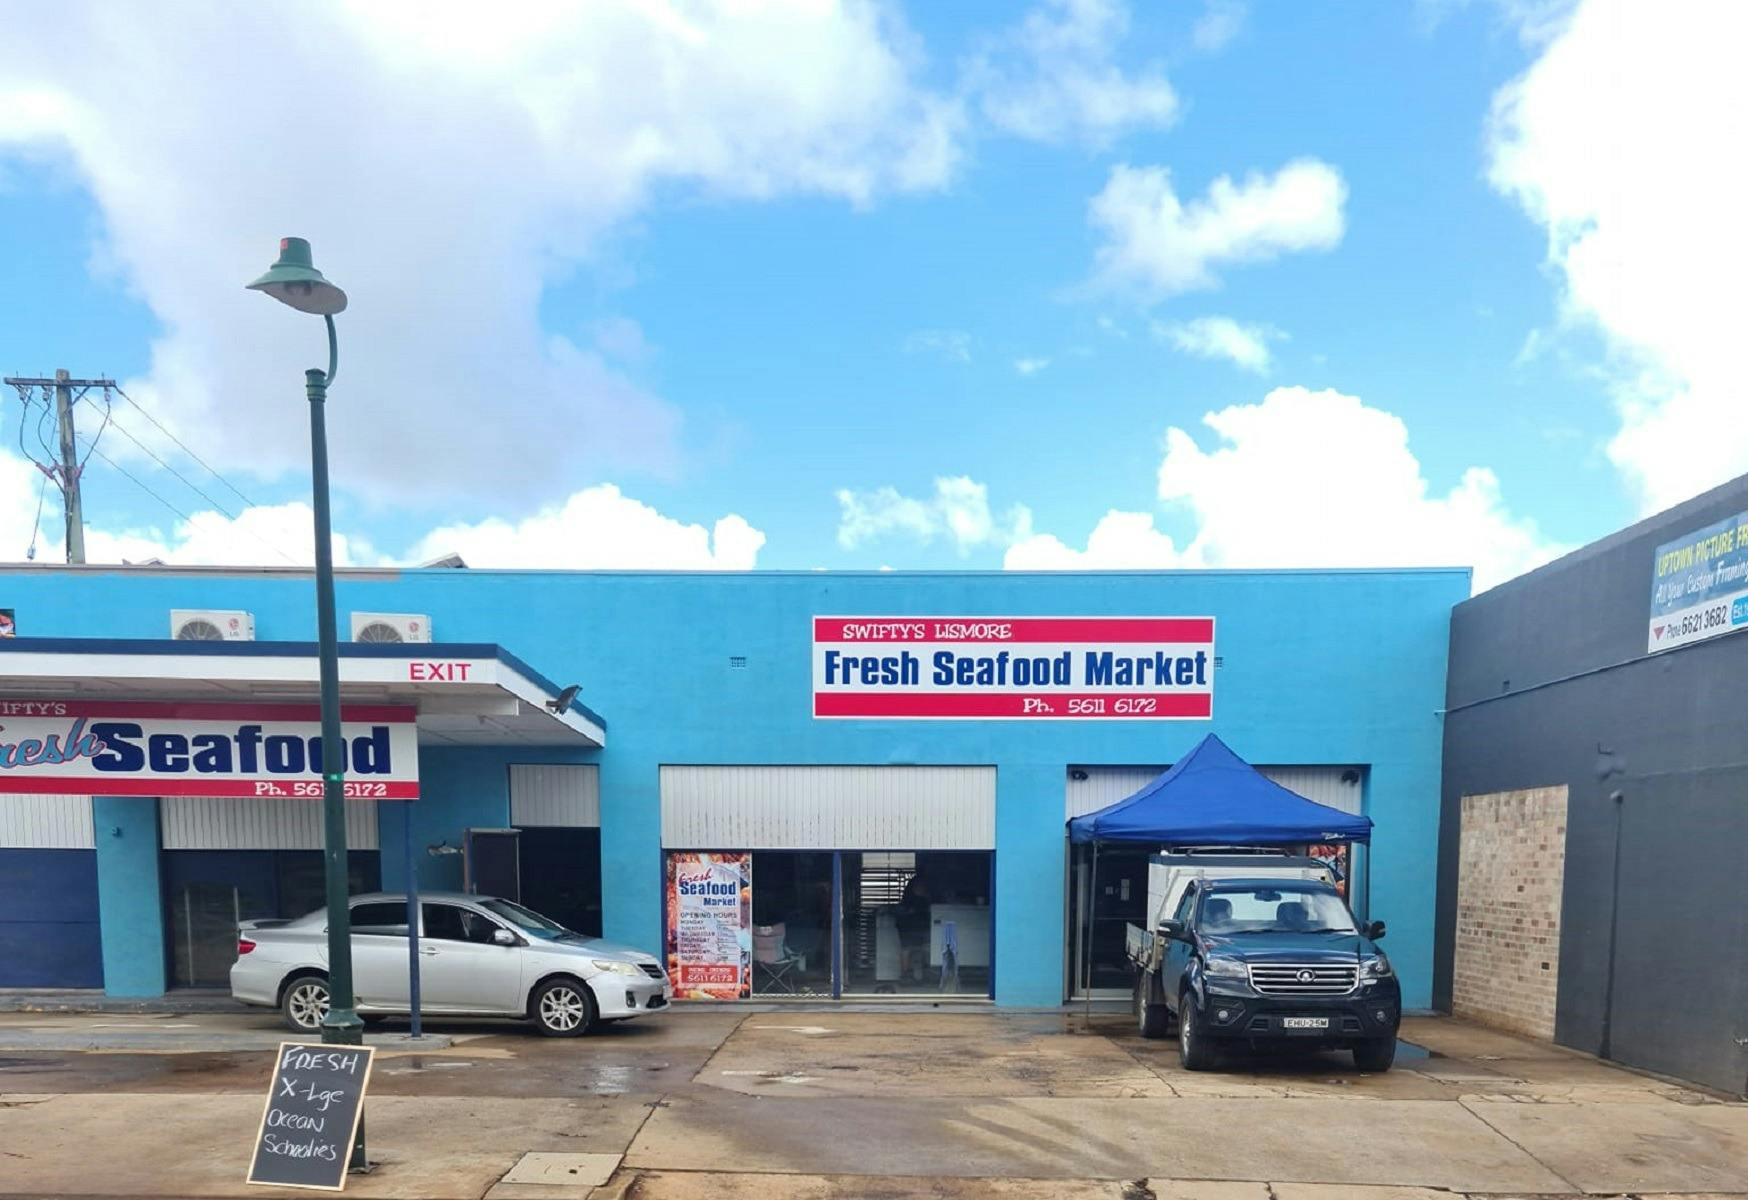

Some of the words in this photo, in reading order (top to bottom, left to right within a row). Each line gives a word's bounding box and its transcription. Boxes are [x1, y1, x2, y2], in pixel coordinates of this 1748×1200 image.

[1658, 544, 1693, 576] UPTOWN
[1696, 529, 1734, 562] PICTURE
[843, 624, 925, 639] SWIFTY'S
[935, 624, 1012, 639] LISMORE
[410, 663, 471, 681] EXIT
[824, 651, 919, 685] Fresh
[932, 651, 1071, 686] Seafood
[1085, 651, 1208, 686] Market
[0, 702, 66, 714] IFTY'S
[1023, 698, 1054, 713] Ph.
[1068, 698, 1106, 713] 5611
[1114, 698, 1156, 713] 6172
[0, 717, 106, 768] resh
[90, 723, 391, 774] Seafood
[255, 782, 287, 795] Ph.
[294, 783, 324, 796] 561
[680, 881, 736, 895] Seafood
[704, 898, 736, 906] Market
[281, 1046, 358, 1074] FRESH
